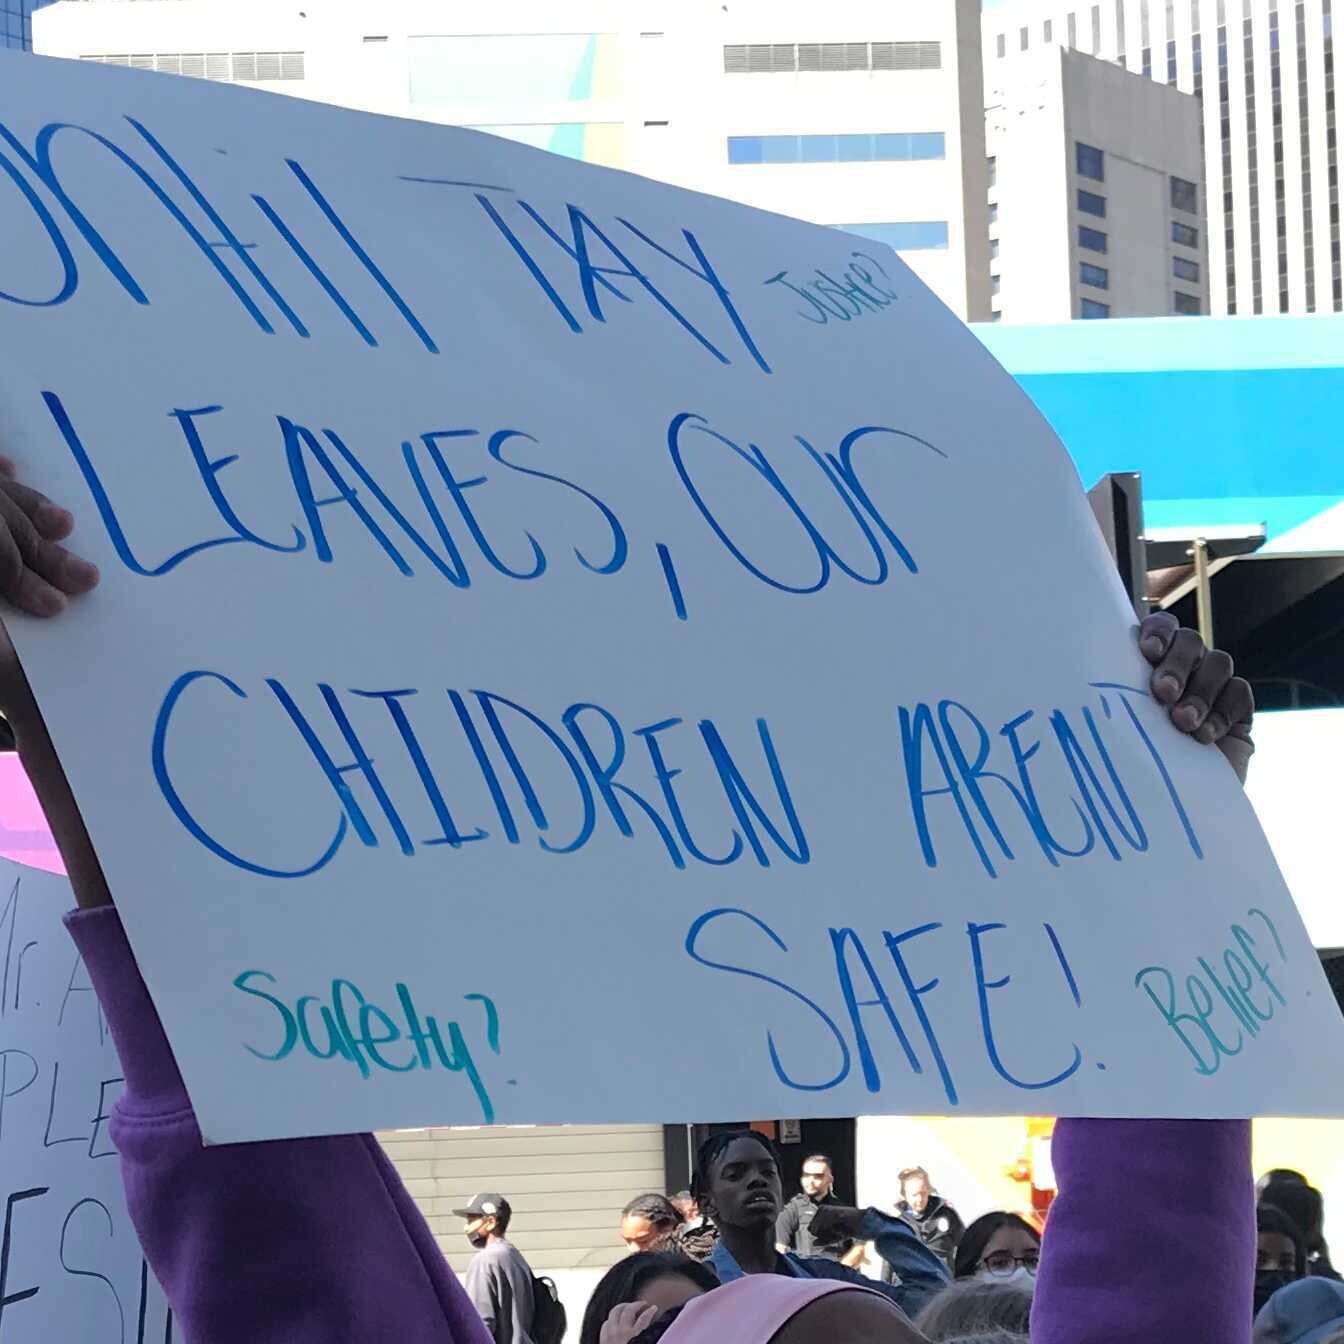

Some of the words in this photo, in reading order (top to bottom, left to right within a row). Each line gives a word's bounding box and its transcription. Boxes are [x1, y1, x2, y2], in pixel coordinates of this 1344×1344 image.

[397, 175, 773, 375] TAY
[41, 390, 688, 622] LEAVES,
[233, 969, 517, 1125] Safety?
[685, 908, 1106, 1106] SAFE!
